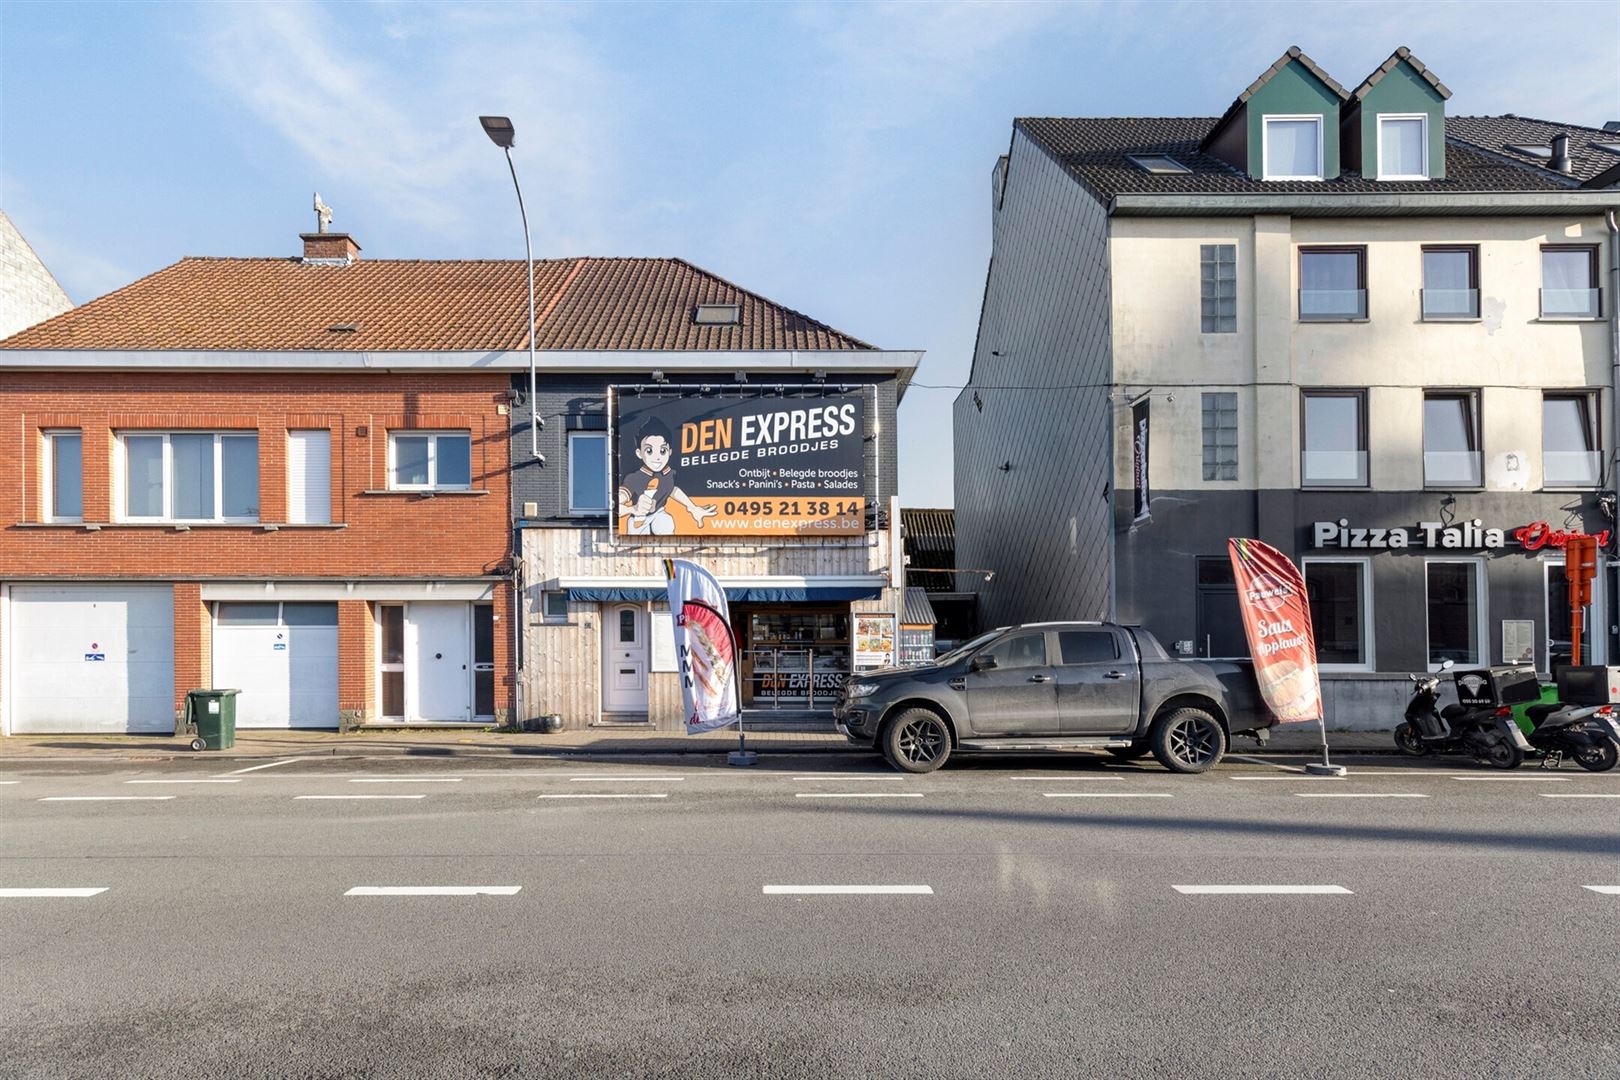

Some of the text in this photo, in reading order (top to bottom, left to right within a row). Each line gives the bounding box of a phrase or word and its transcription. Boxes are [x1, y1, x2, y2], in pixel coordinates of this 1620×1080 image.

[681, 404, 856, 454] DEN EXPRESS
[680, 439, 840, 467] BELEGDE BROODJES
[738, 468, 858, 479] Ontbijt Belegde broodjes
[706, 480, 858, 489] Snack's Panini's Pasta Salades
[724, 501, 859, 516] 0495 21 38 14
[711, 518, 859, 531] www.denexpress.be
[1314, 518, 1505, 548] Pizza Talia
